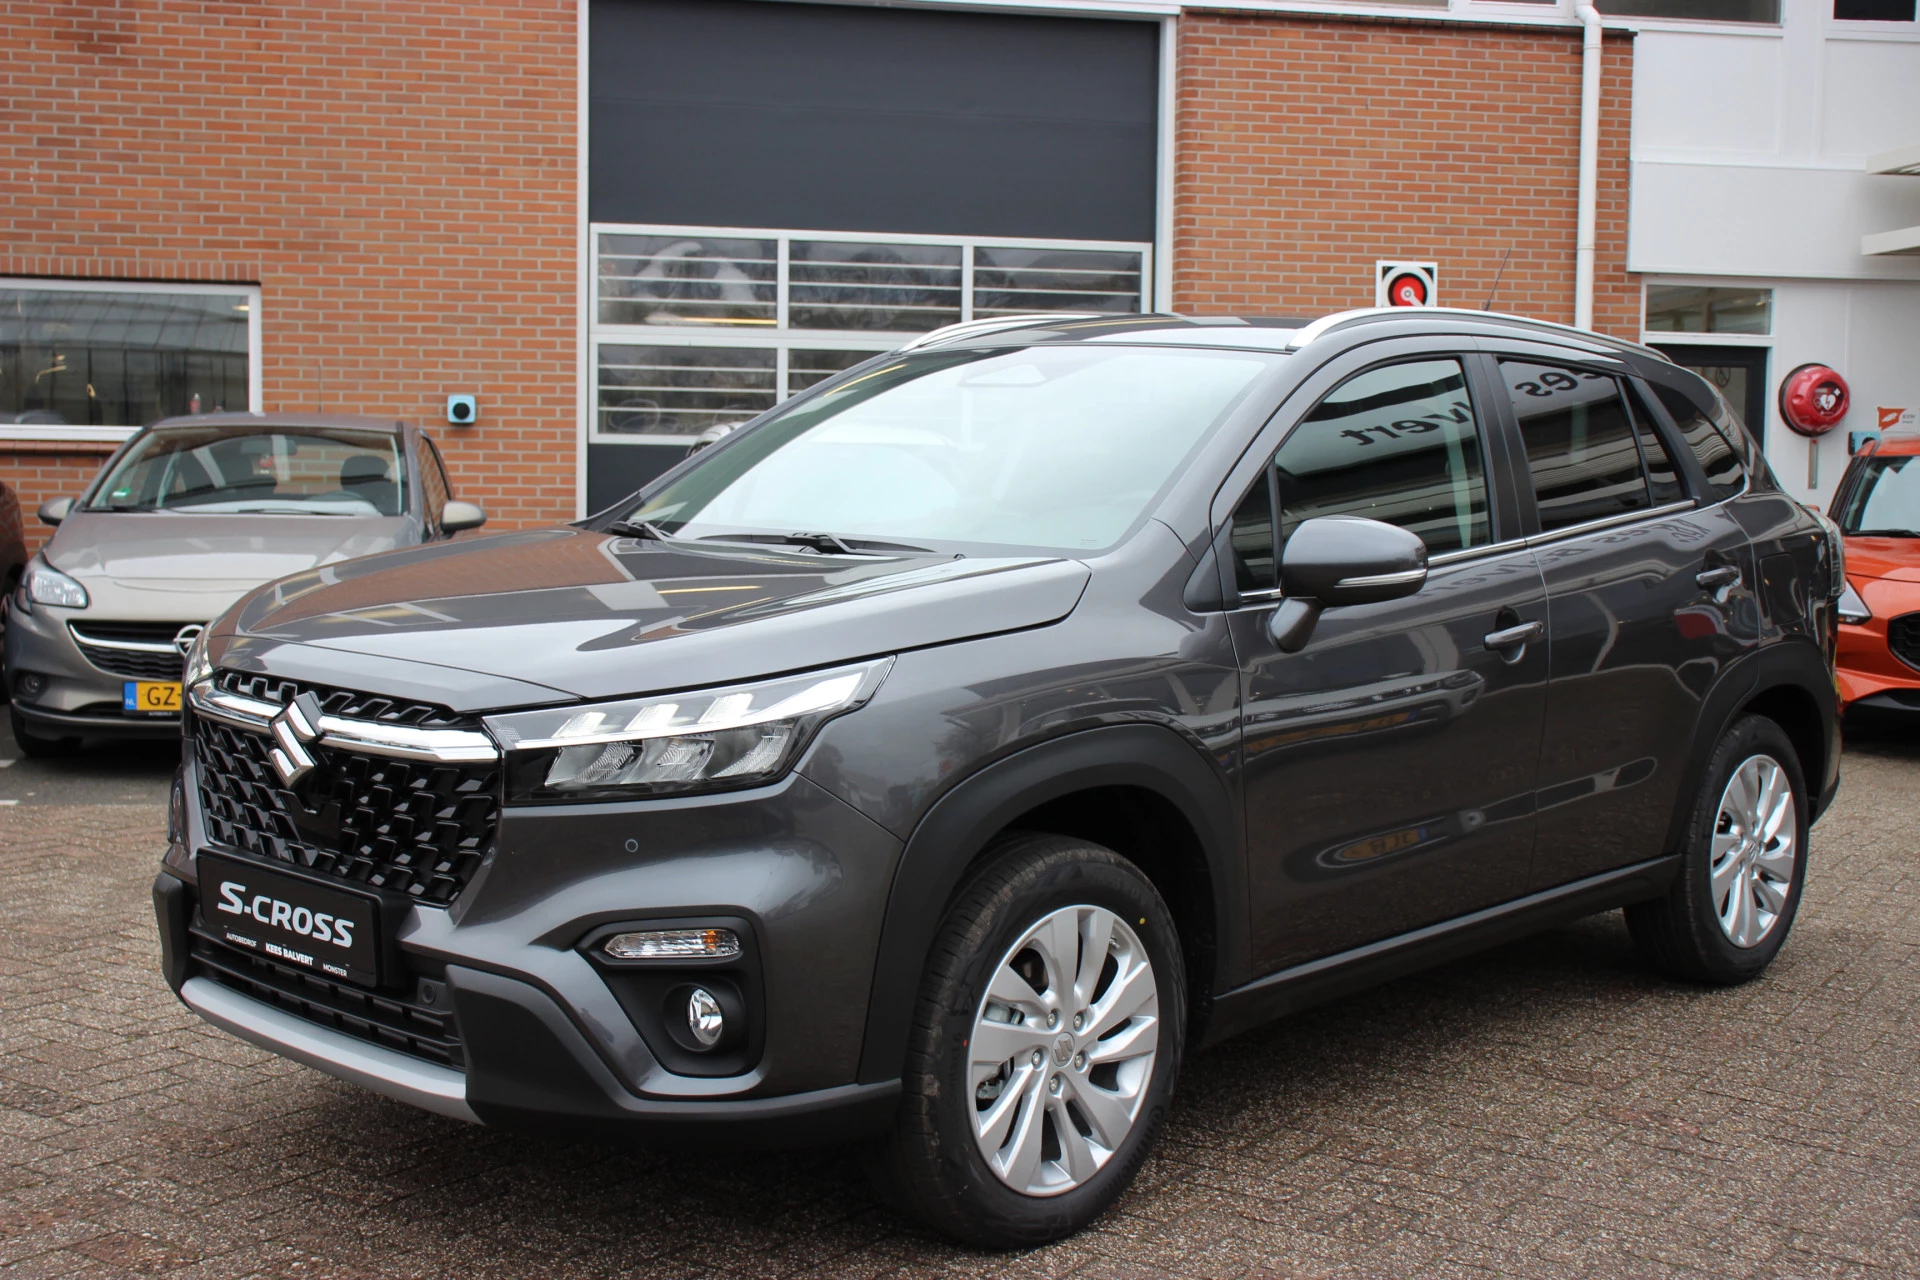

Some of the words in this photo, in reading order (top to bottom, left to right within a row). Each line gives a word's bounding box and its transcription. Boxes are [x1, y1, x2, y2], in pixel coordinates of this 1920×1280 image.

[265, 942, 283, 957] KEES
[283, 947, 314, 966] BALVERT
[323, 963, 348, 978] MONSTER
